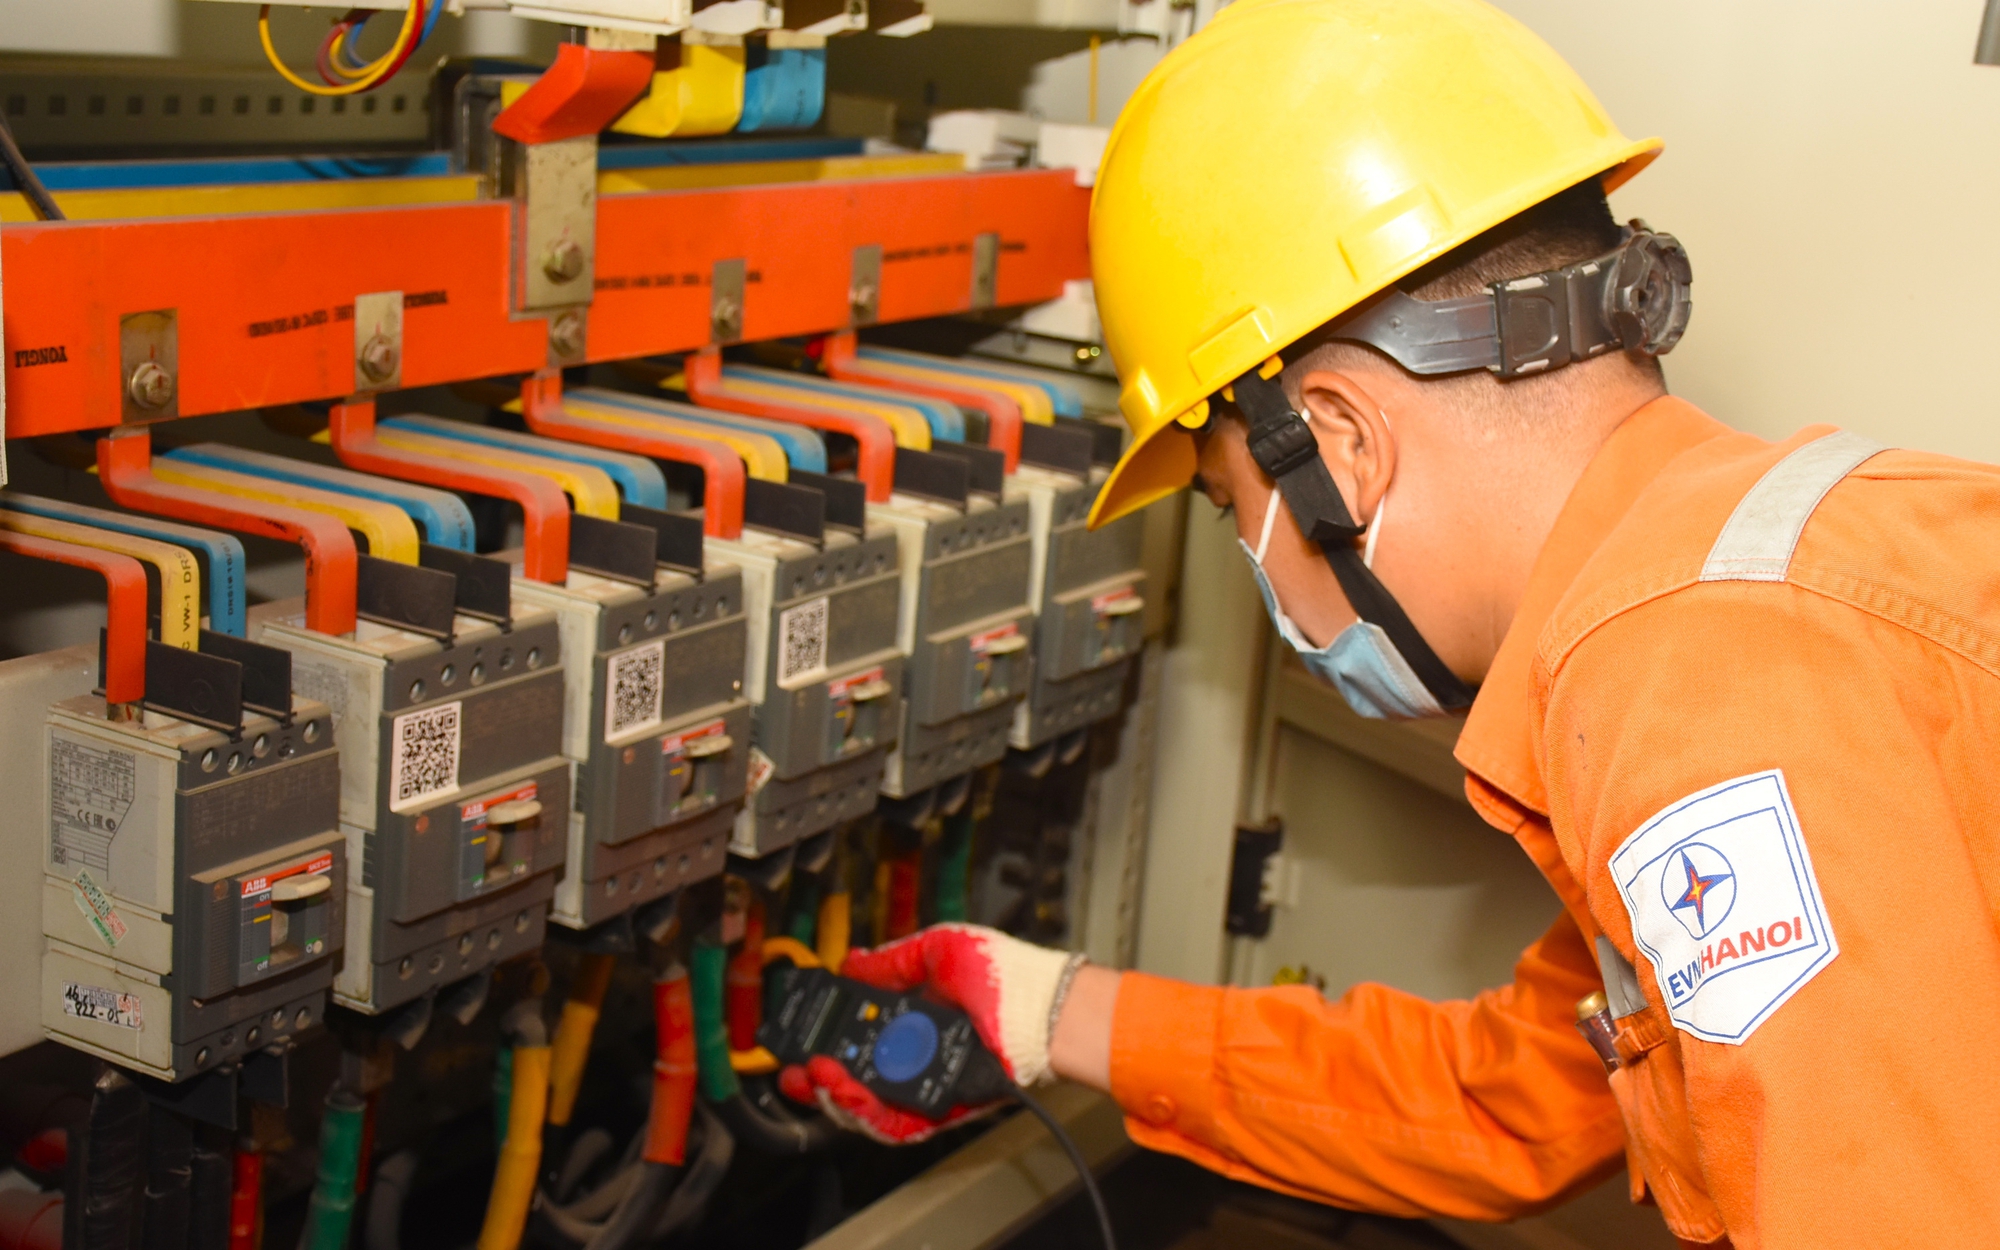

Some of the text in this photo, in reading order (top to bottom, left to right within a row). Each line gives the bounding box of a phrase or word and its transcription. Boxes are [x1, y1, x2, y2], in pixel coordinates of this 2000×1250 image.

[15, 346, 68, 368] YONGLI
[182, 595, 191, 633] VW-1
[244, 877, 267, 894] ABB
[259, 893, 271, 902] on
[257, 960, 269, 971] off
